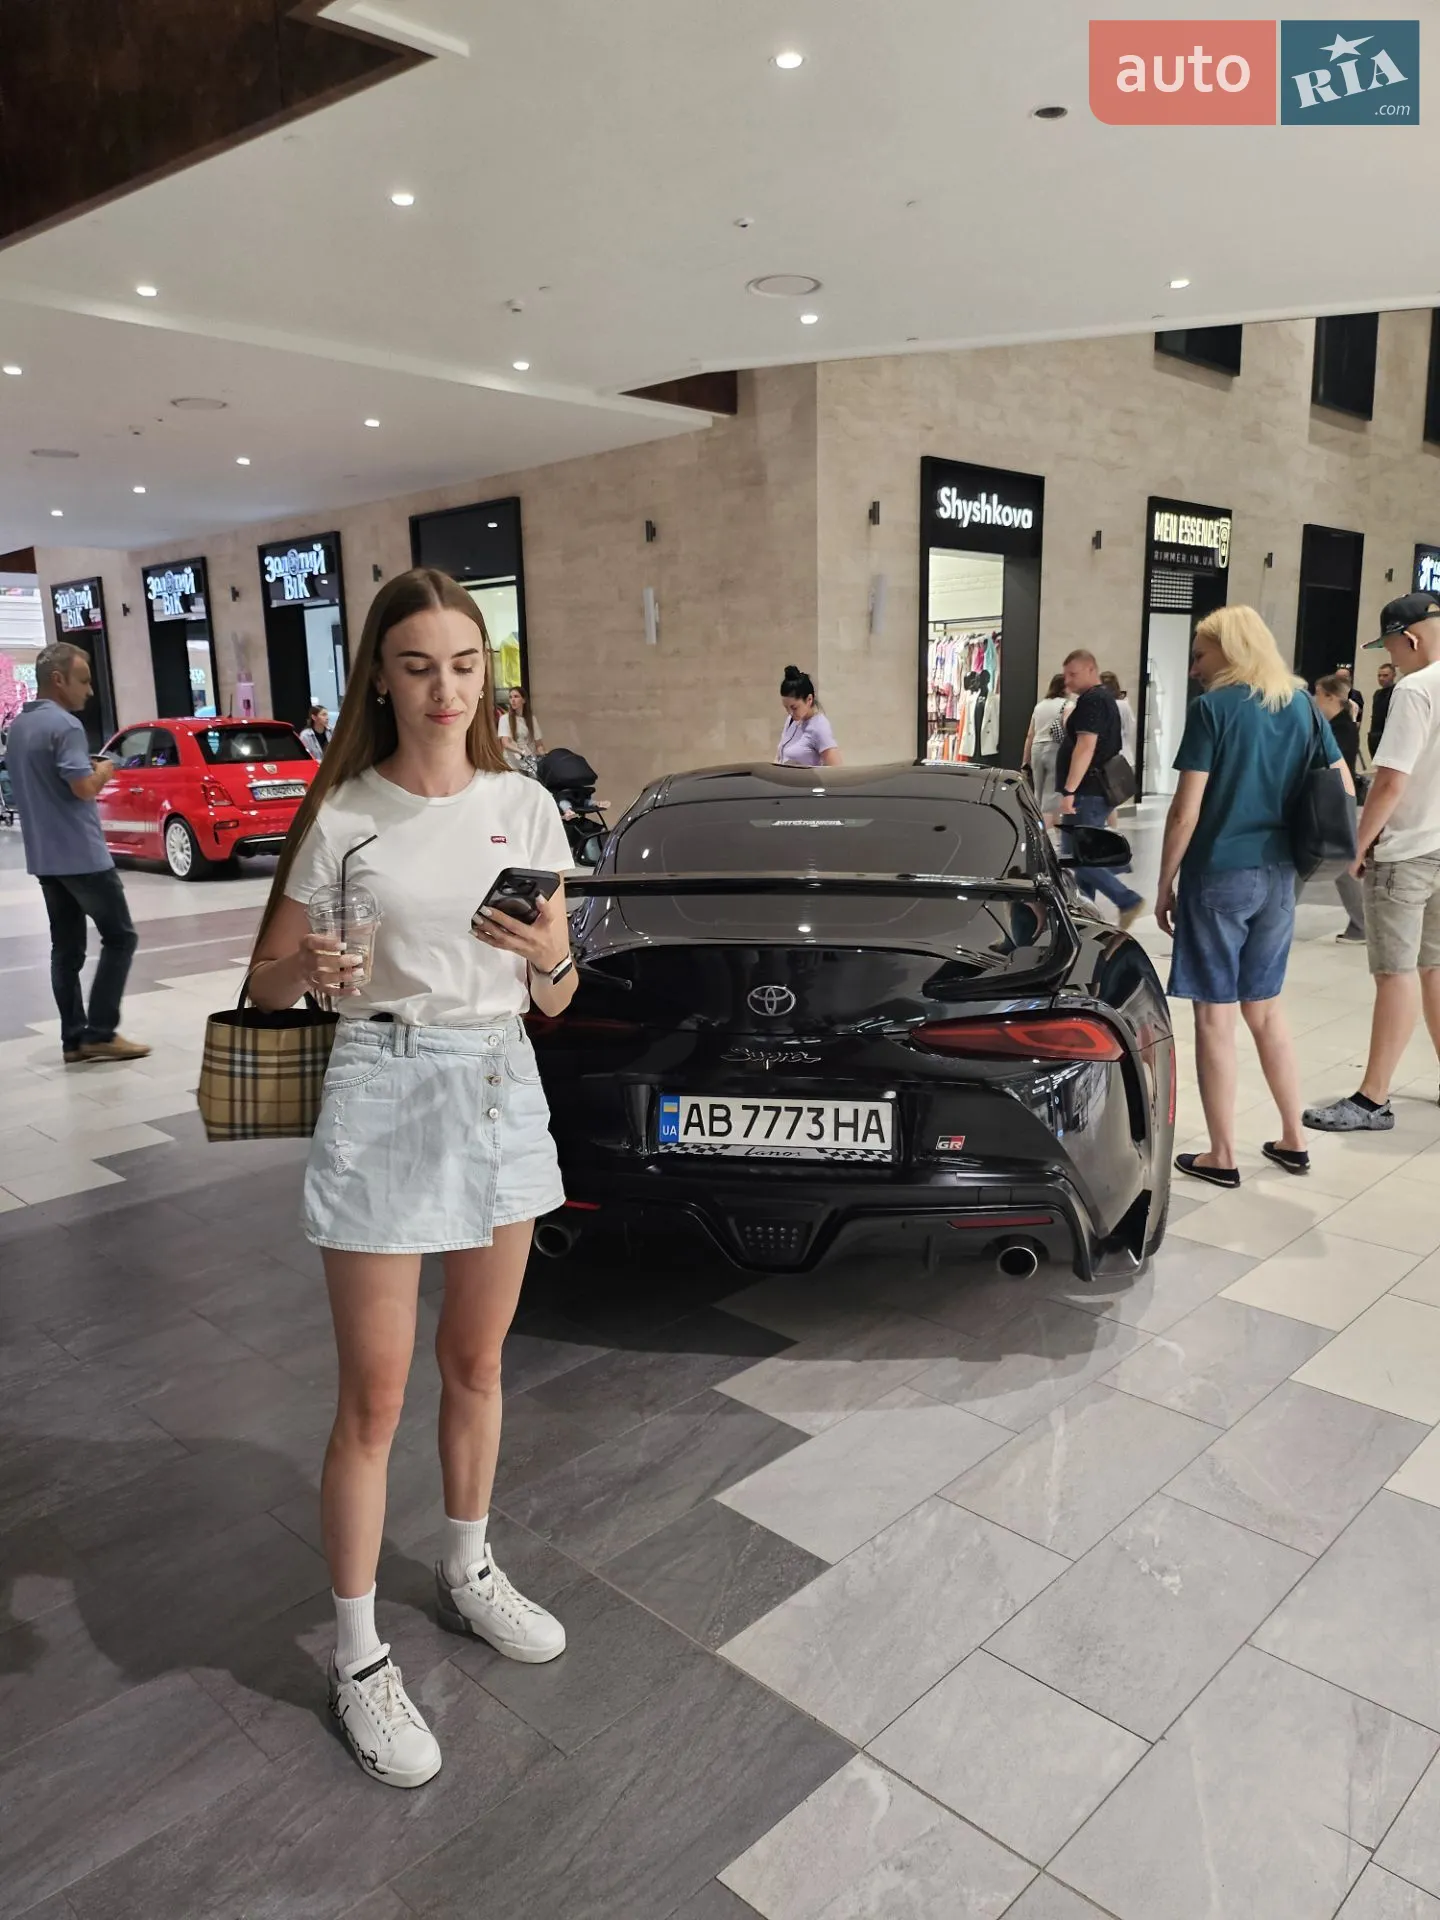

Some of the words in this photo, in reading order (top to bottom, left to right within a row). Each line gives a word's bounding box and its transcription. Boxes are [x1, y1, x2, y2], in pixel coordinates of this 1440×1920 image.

[938, 486, 1033, 529] Shyshkova
[1154, 511, 1178, 543] MEN
[1178, 514, 1221, 549] ESSENCE
[662, 1125, 678, 1137] UA
[682, 1103, 733, 1138] AB
[741, 1104, 825, 1141] 7773
[833, 1107, 886, 1144] HA
[937, 1141, 963, 1150] GR
